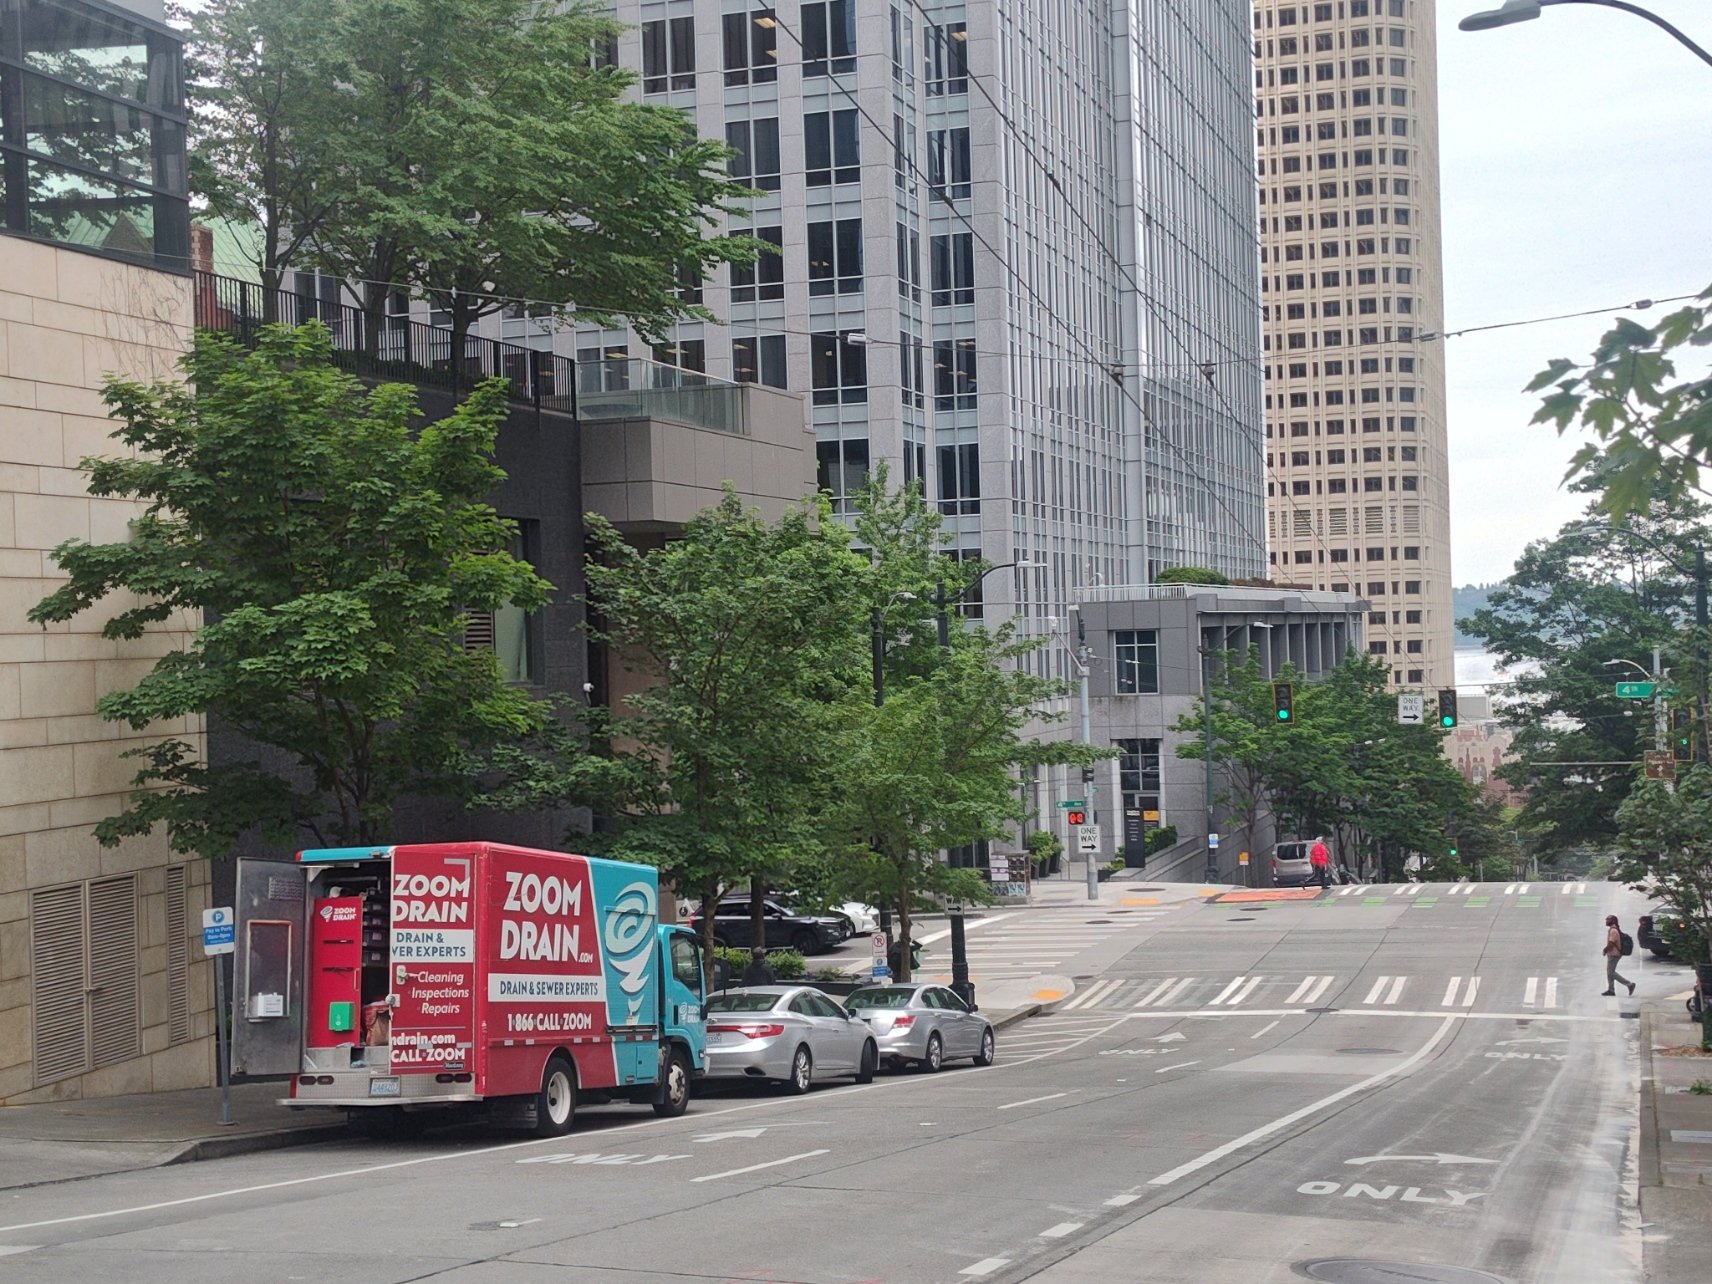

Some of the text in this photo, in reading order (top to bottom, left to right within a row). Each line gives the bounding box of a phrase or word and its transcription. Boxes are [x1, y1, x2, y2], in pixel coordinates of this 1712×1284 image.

[394, 874, 470, 897] ZOOM
[503, 871, 581, 916] ZOOM
[391, 900, 468, 923] DRAIN
[396, 932, 445, 943] DRAIN &
[416, 946, 466, 957] EXPERTS
[418, 971, 464, 985] Cleaning
[411, 987, 469, 1001] Inspections
[500, 981, 598, 996] DRAIN & SEWER EXPERTS
[421, 1002, 460, 1016] Repairs
[1484, 1052, 1568, 1061] ONLY
[515, 1153, 694, 1165] ONLY
[1296, 1181, 1487, 1206] ONLY
